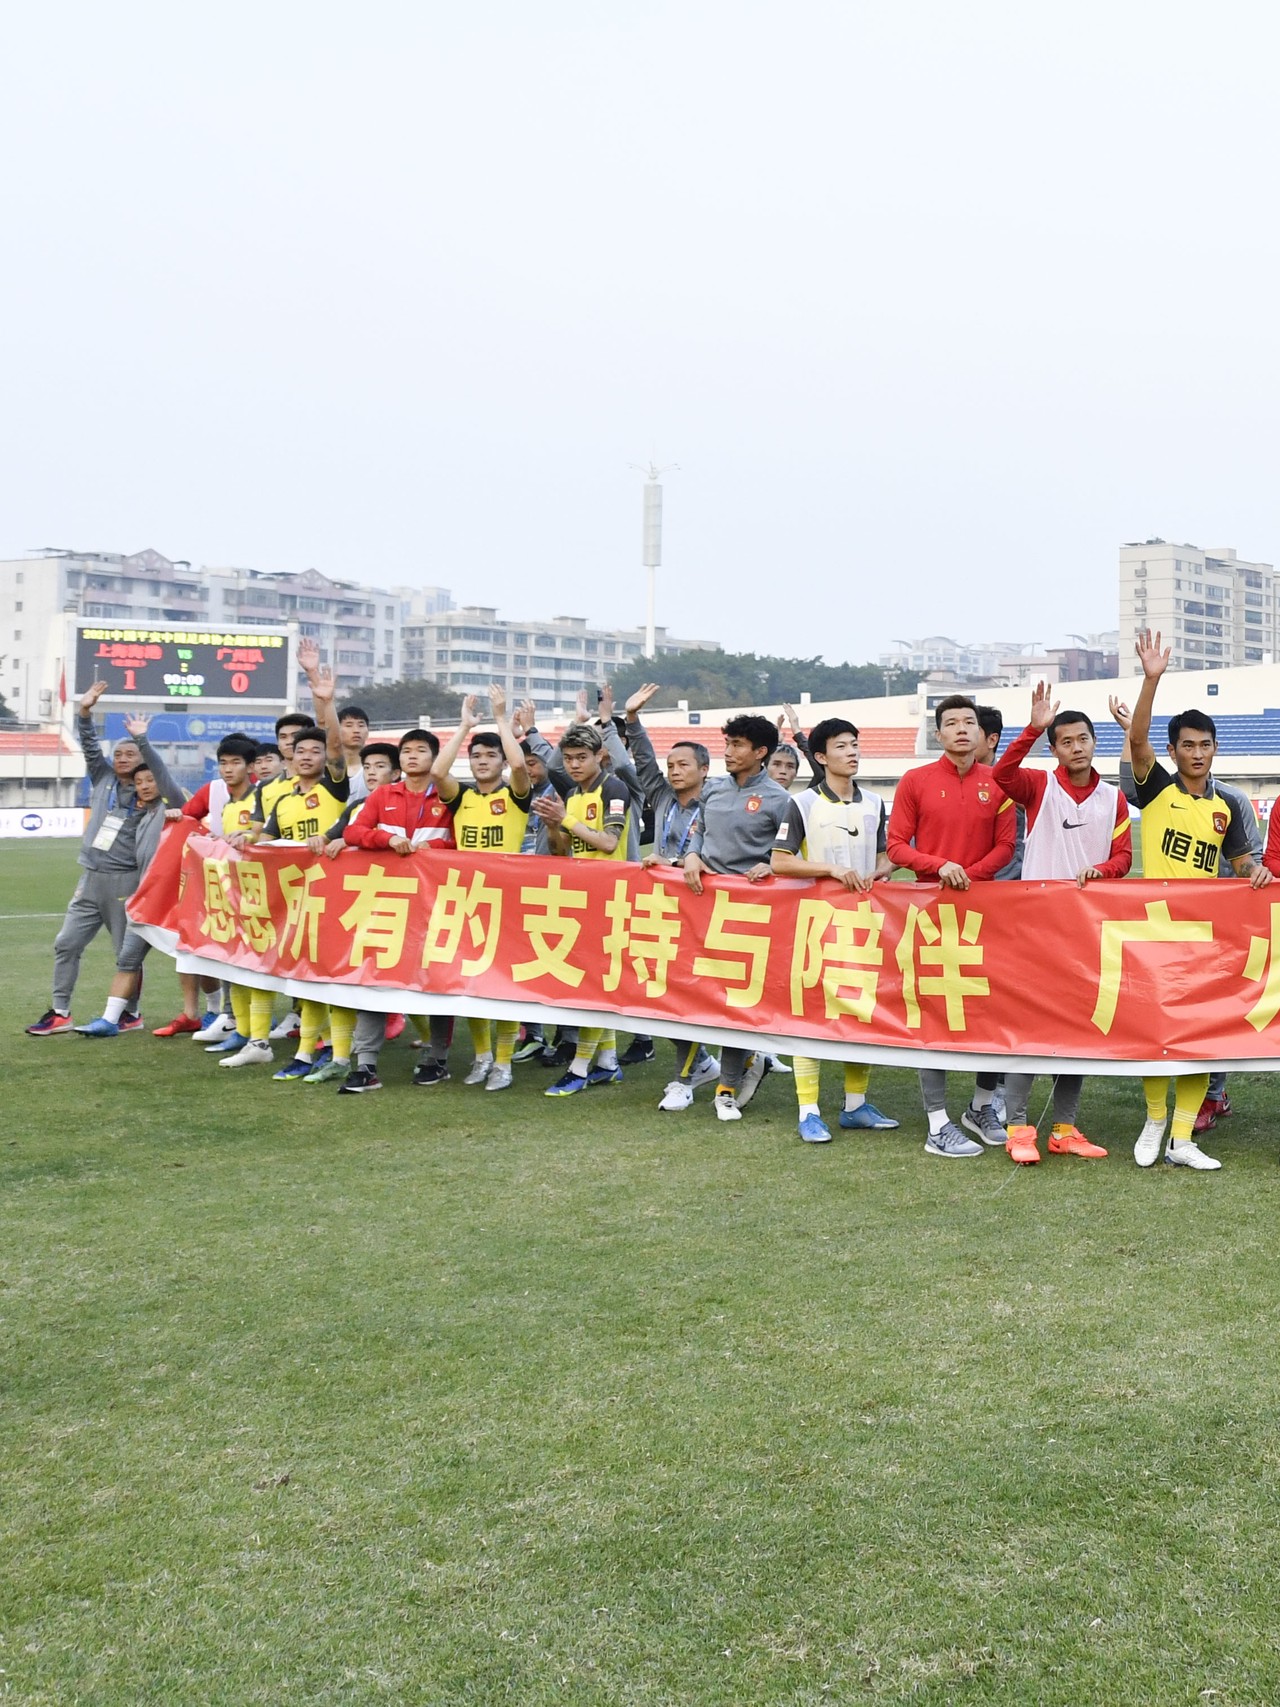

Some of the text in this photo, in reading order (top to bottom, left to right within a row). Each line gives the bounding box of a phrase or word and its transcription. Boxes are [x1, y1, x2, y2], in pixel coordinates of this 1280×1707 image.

[176, 649, 193, 660] VS
[216, 647, 265, 663] 广州队
[123, 669, 137, 690] 1
[163, 674, 205, 685] 90:00
[230, 672, 250, 693] 0
[940, 790, 946, 798] 3
[461, 824, 504, 849] 恒驰
[1161, 827, 1218, 873] 恒驰
[199, 857, 991, 1032] 感恩所有的支持与陪伴
